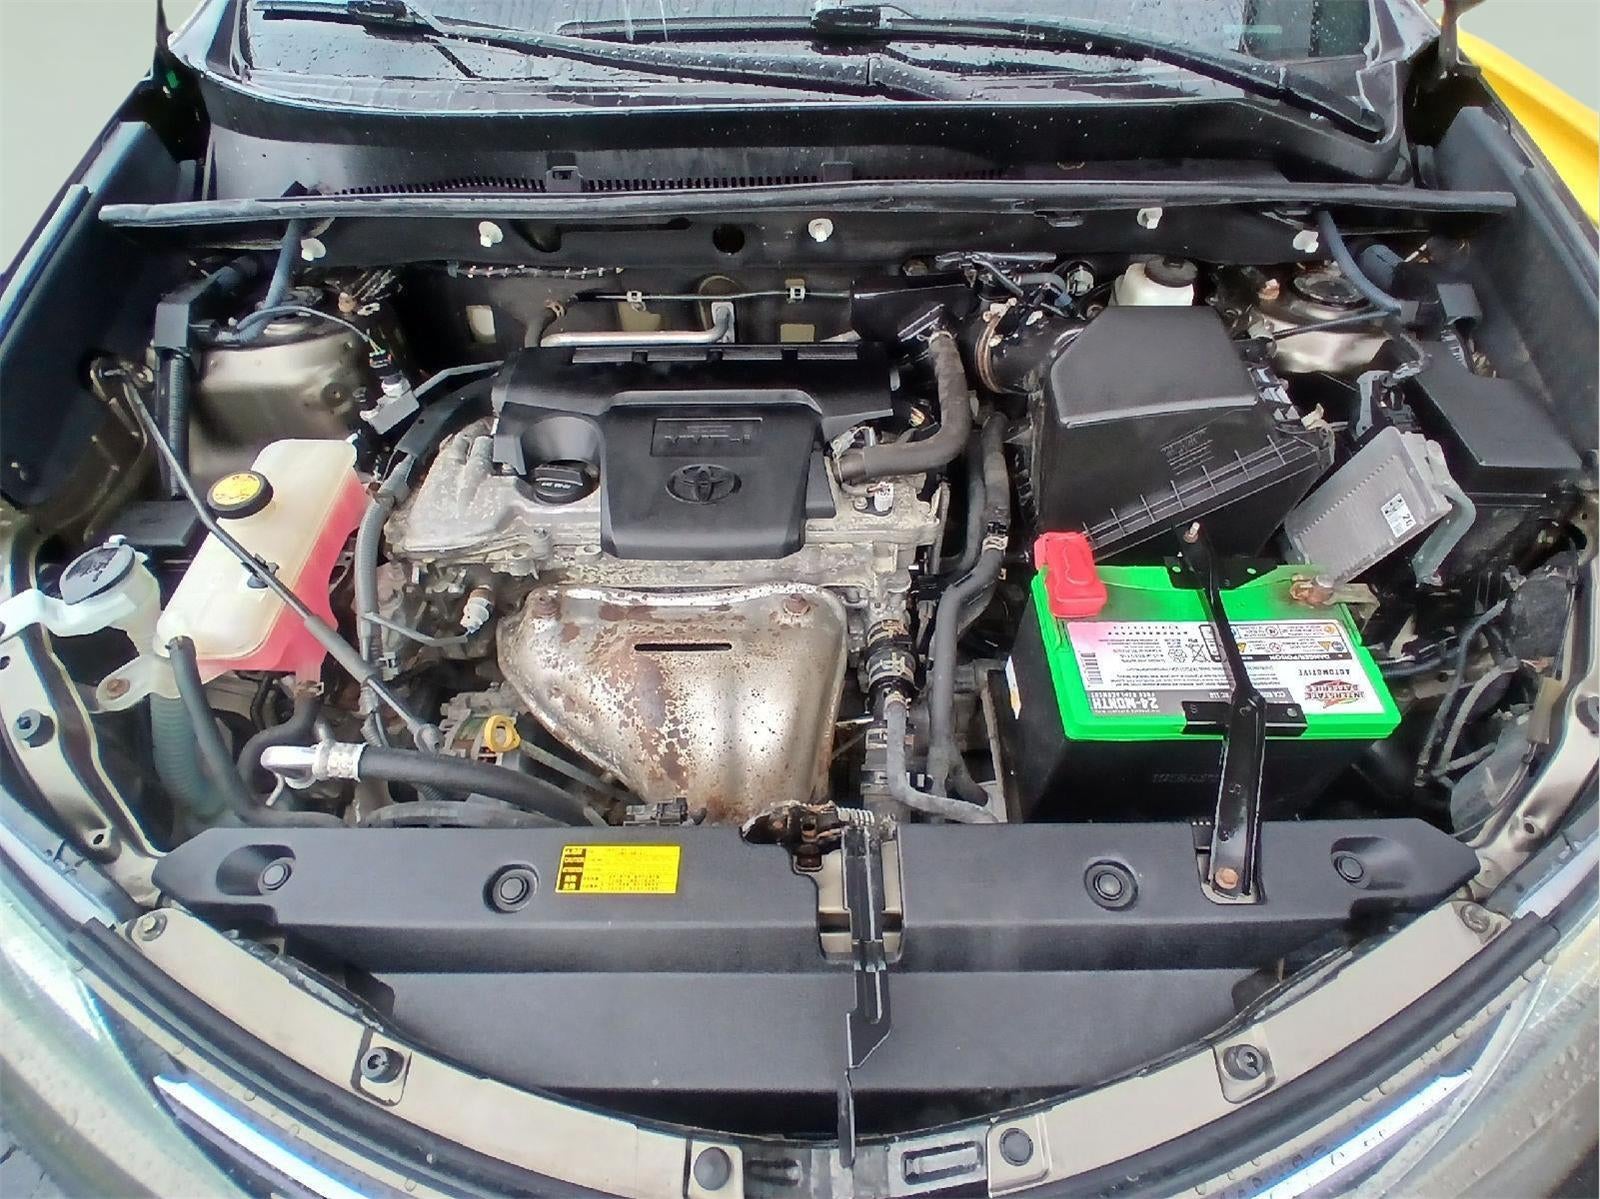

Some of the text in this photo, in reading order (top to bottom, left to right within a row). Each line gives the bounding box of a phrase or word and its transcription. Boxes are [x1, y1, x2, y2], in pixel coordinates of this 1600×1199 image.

[1305, 684, 1358, 692] BATTERIES
[1304, 691, 1364, 700] INTERSTATE
[1092, 697, 1159, 709] 24-MONTH
